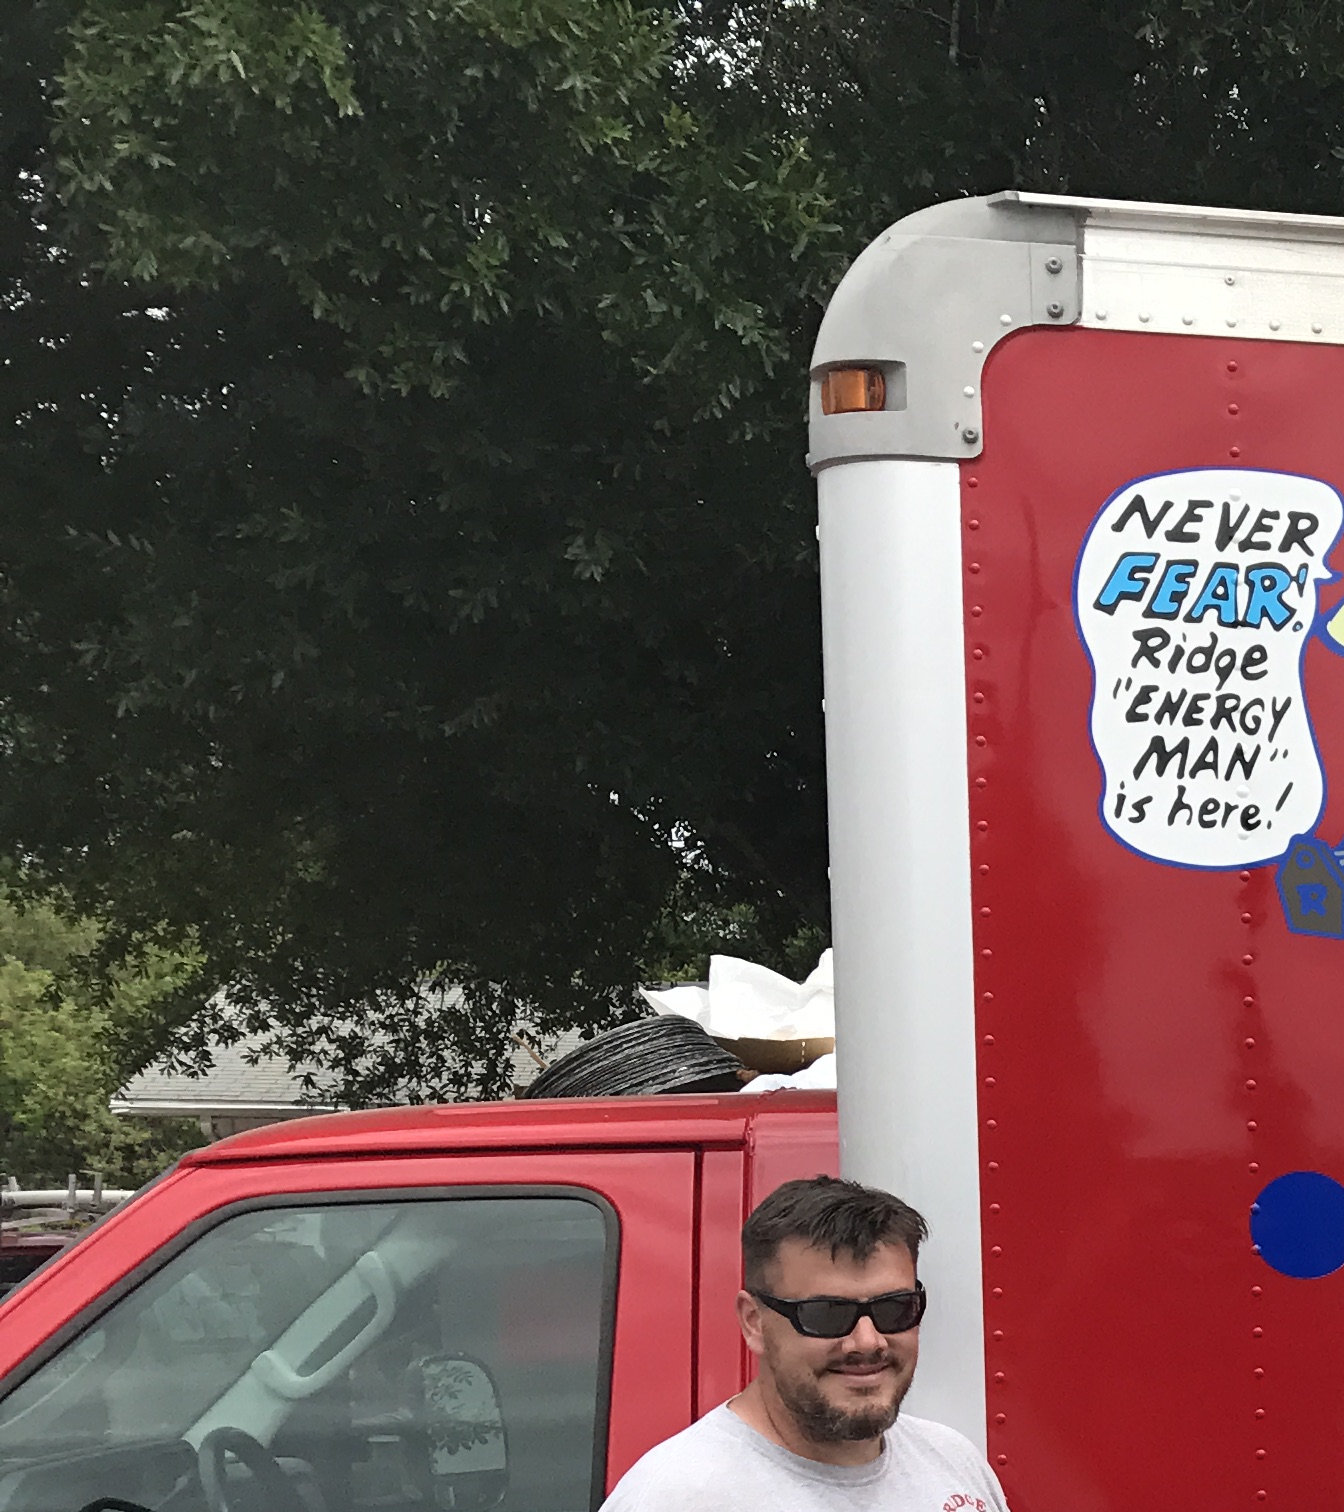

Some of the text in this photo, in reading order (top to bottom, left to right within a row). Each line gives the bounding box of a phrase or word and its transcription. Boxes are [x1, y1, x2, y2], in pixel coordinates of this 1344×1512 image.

[1111, 494, 1319, 557] NEVER
[1093, 552, 1308, 632] FEAR!
[1131, 627, 1268, 691] Ridge
[1114, 780, 1294, 831] is here!
